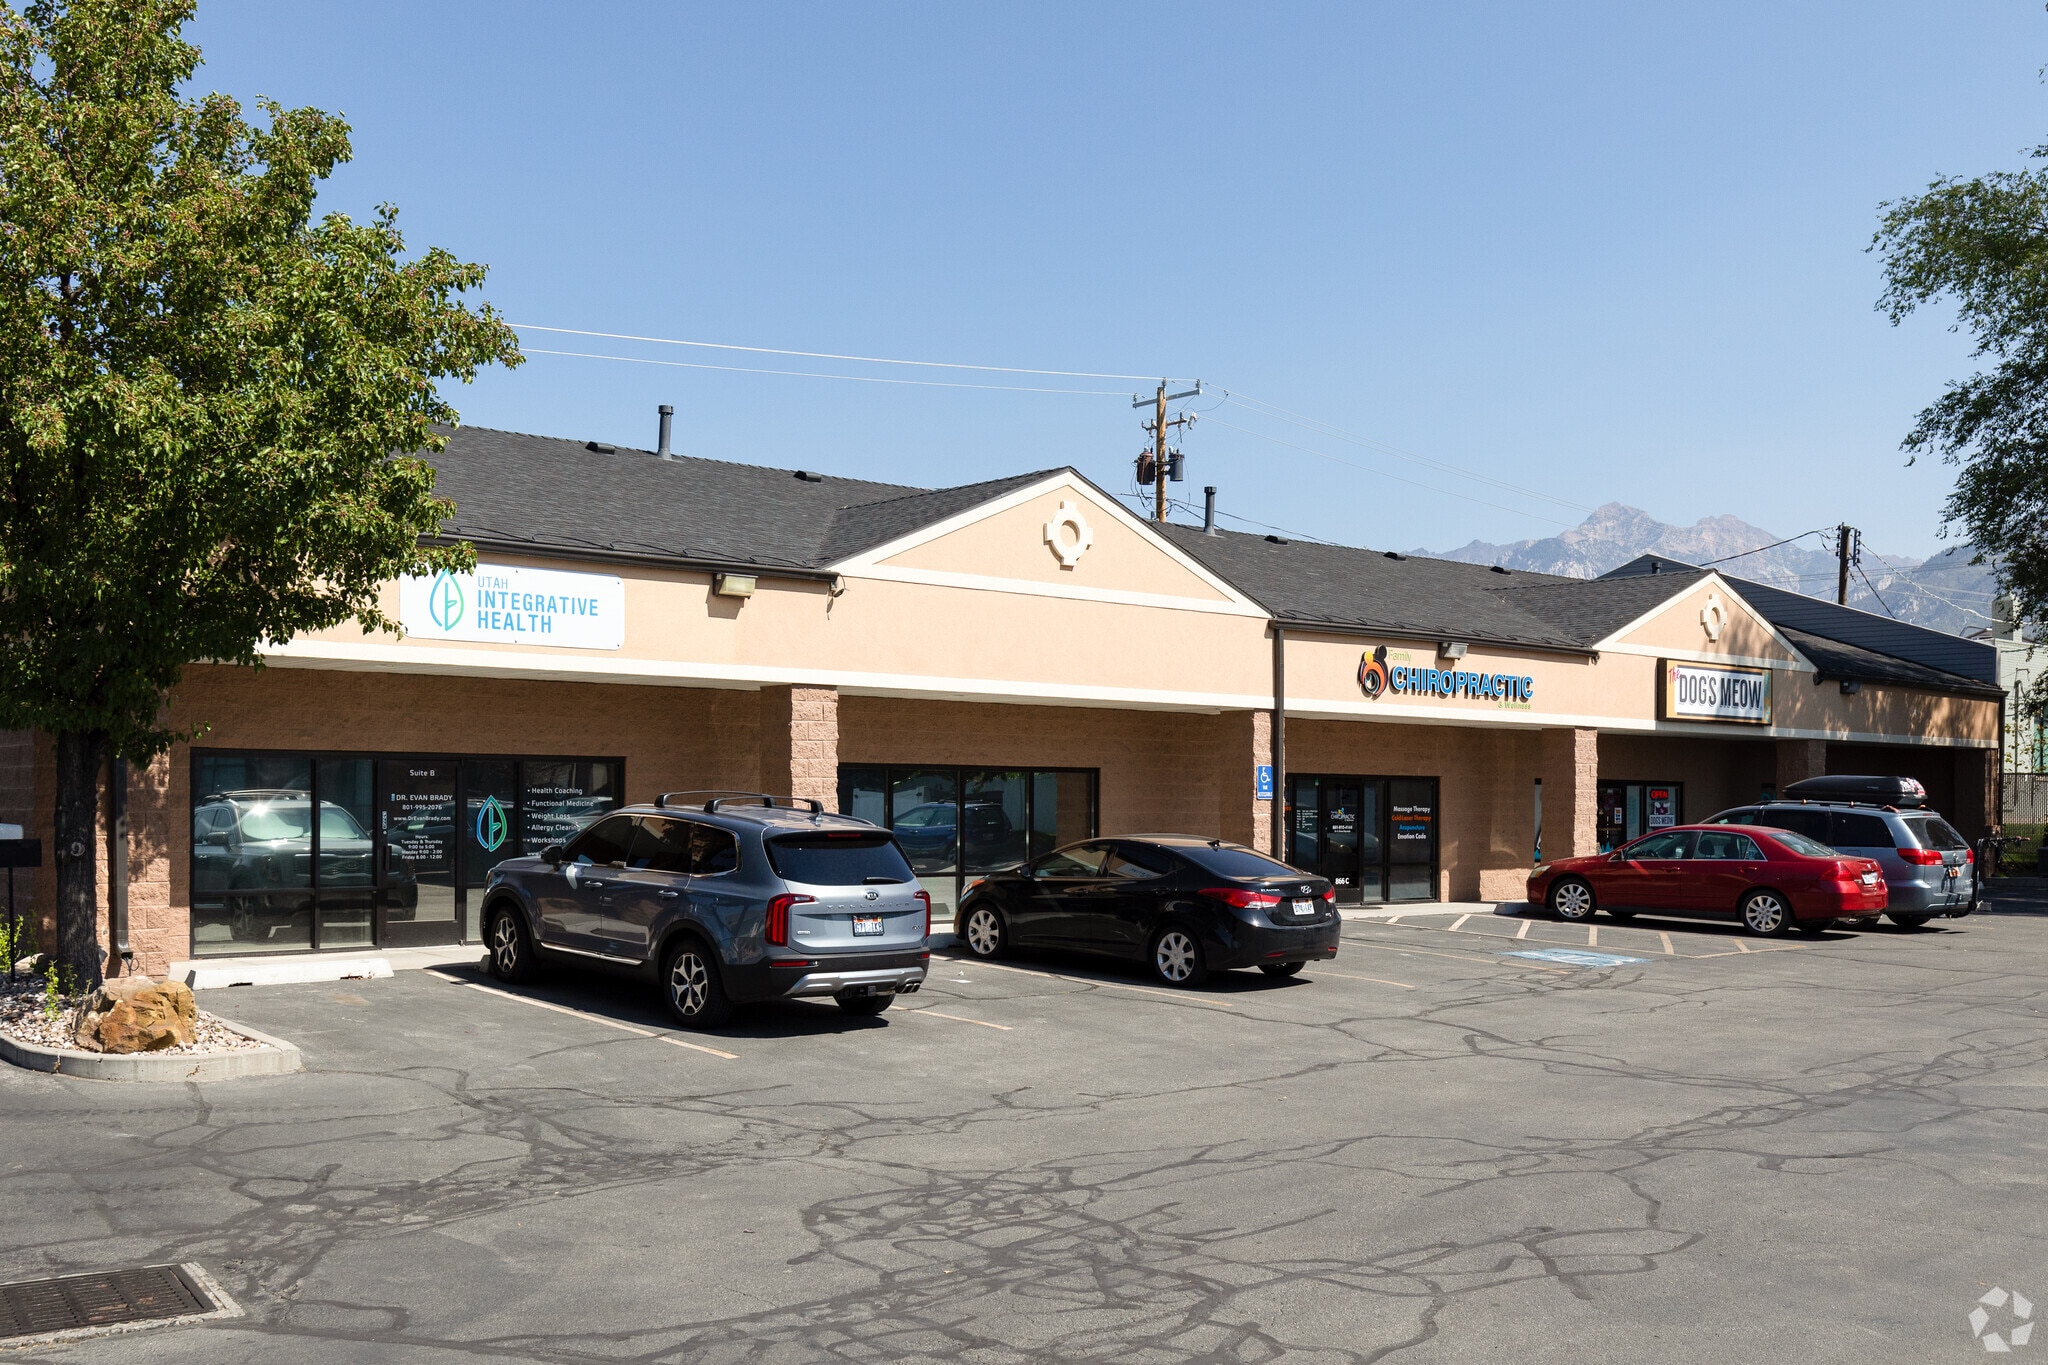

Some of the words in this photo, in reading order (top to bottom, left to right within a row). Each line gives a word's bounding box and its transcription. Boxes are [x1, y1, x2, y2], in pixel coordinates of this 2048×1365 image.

[477, 576, 509, 590] UTAH
[477, 589, 599, 617] INTEGRATIVE
[477, 610, 552, 634] HEALTH
[1388, 649, 1412, 664] Family
[1667, 666, 1681, 685] The
[1391, 665, 1534, 699] CHIROPRACTIC
[1679, 673, 1717, 706] DOG'S
[1720, 677, 1763, 709] MEOW
[1504, 701, 1532, 710] Wellness
[409, 769, 428, 777] Suite
[429, 769, 436, 777] B
[554, 787, 583, 795] Coaching
[1651, 790, 1669, 799] OPEN
[1393, 805, 1413, 813] Massage
[1413, 805, 1431, 814] Therapy
[531, 824, 554, 832] Allergy
[865, 892, 878, 900] KIA
